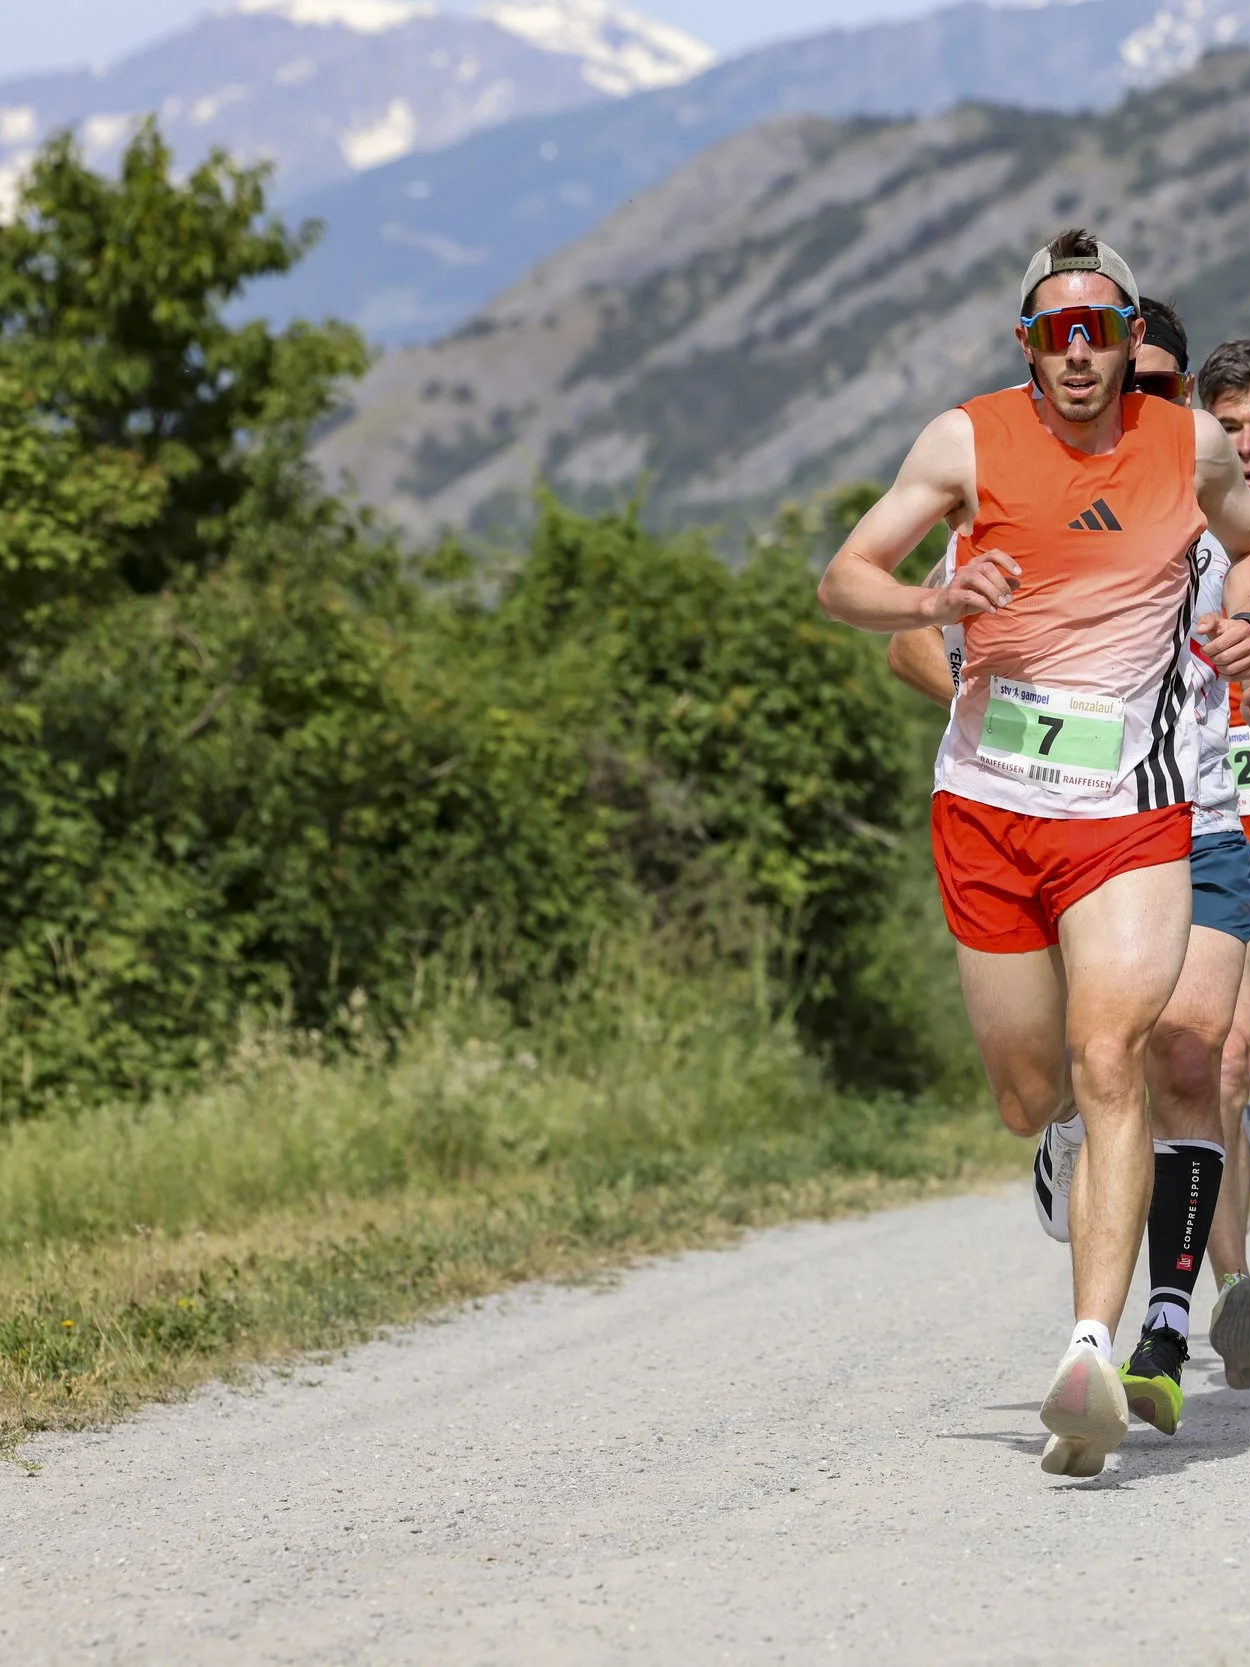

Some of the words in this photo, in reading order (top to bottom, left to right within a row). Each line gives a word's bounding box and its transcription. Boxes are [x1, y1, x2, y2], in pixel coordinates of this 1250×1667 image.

[1000, 685, 1012, 697] stv
[1020, 690, 1050, 705] gampel
[1070, 697, 1115, 714] lonzalauf
[1037, 715, 1064, 756] 7
[980, 755, 1025, 774] RAIFFEISEN
[1062, 775, 1112, 789] RAIFFEISEN
[1183, 1161, 1200, 1250] COMPRESSPORT
